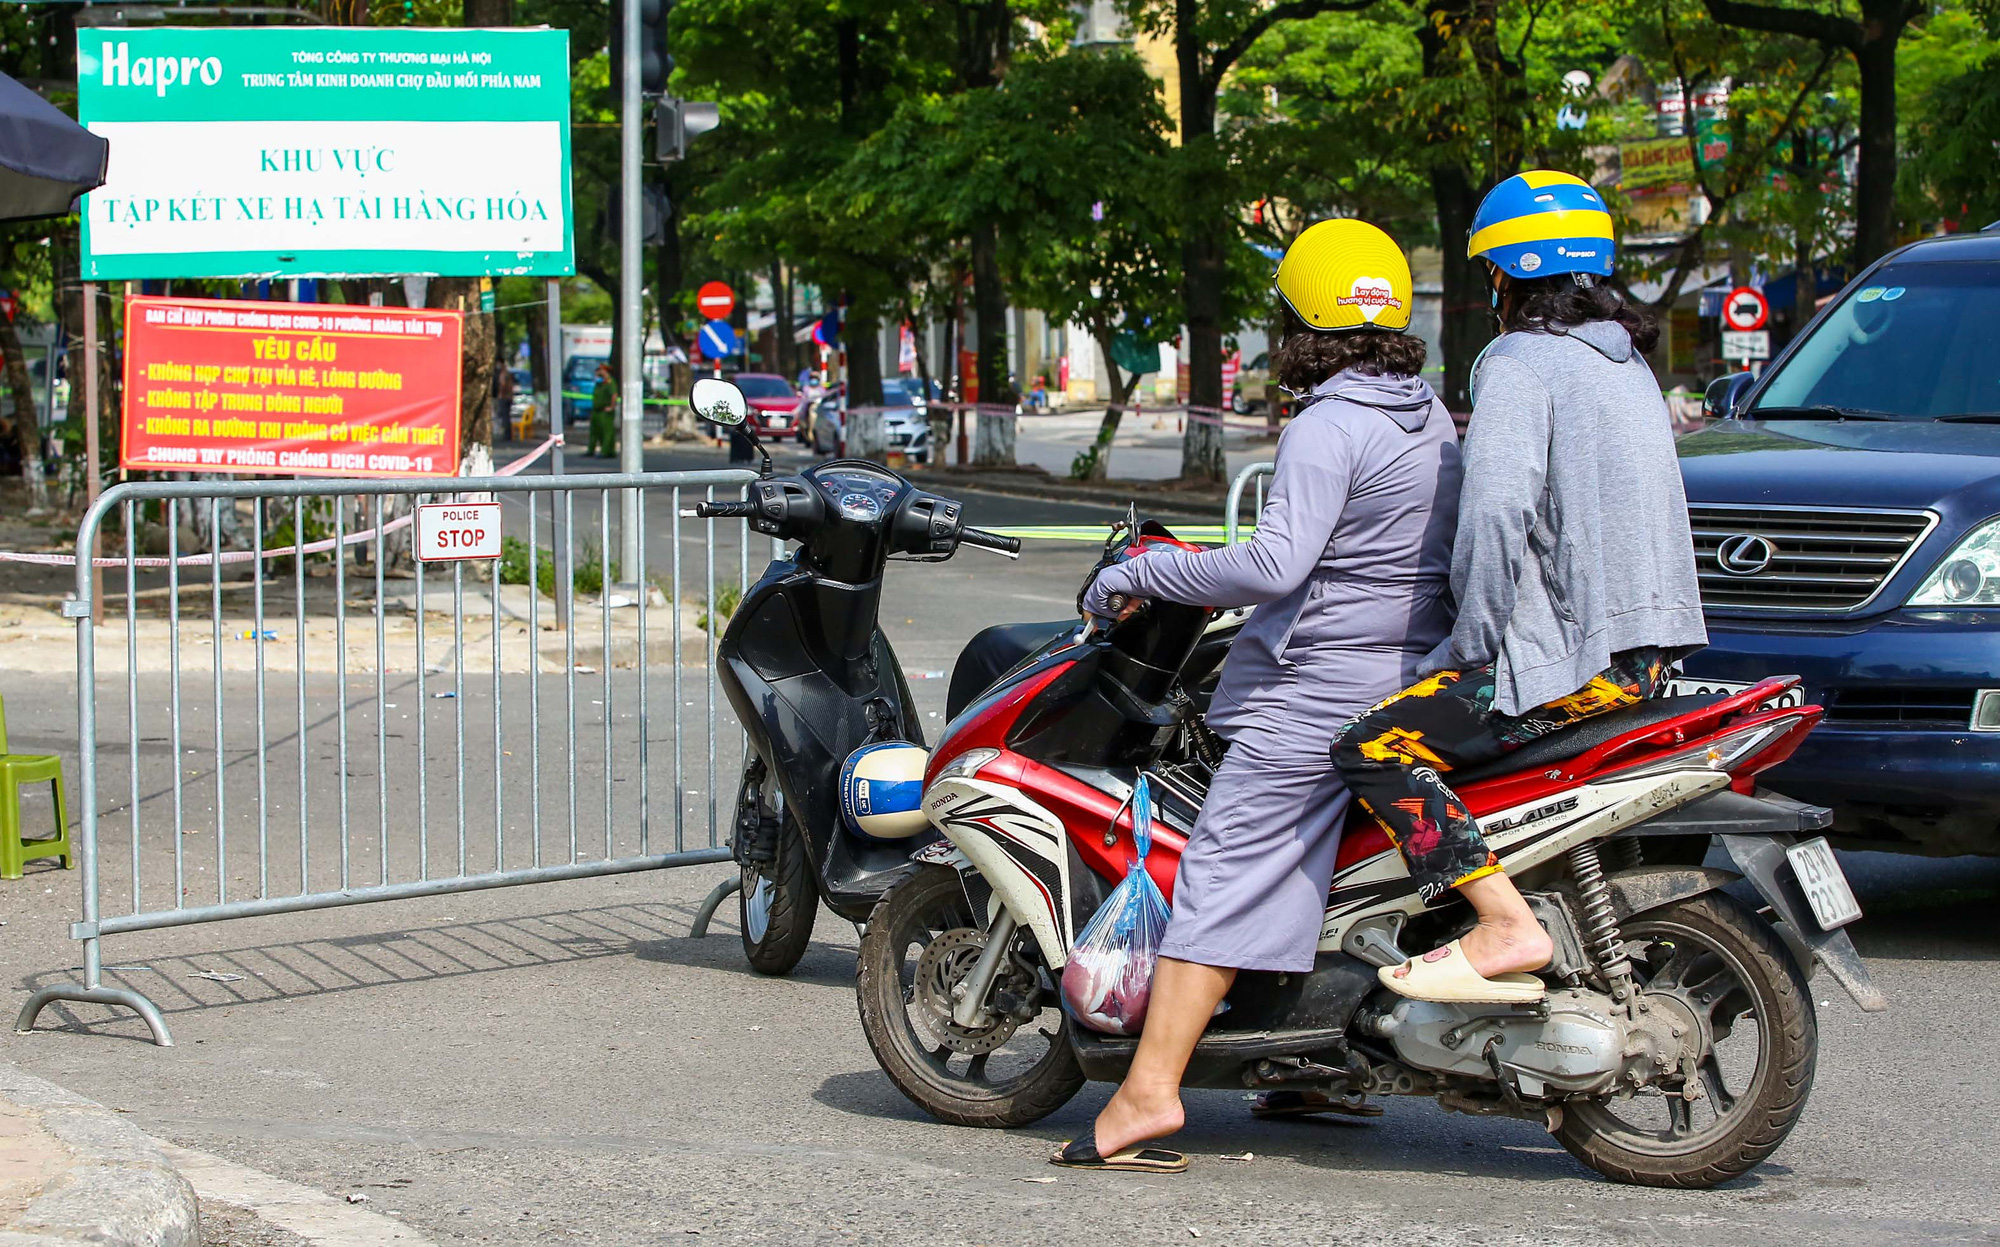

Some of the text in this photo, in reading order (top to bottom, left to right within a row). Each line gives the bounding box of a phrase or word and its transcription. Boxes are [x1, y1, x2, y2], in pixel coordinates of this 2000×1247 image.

[102, 41, 223, 97] Hapro
[326, 49, 360, 64] CÔNG
[362, 52, 376, 64] TY
[430, 53, 451, 66] MẠI
[453, 51, 469, 64] HÀ
[241, 70, 542, 90] TRUNG TÂM KINH DOANH CHỢ ĐẦU MỐI PHÍA NAM
[260, 145, 395, 178] KHU VỰC
[103, 194, 160, 229] TẬP
[168, 190, 227, 222] KẾT
[236, 197, 274, 220] XE
[285, 197, 324, 226] HẠ
[393, 189, 476, 221] HÀNG
[486, 190, 548, 221] HÓA
[292, 315, 333, 331] COVID-19
[253, 335, 291, 361] YÊU
[147, 360, 192, 382] KHÔNG
[194, 364, 221, 386] HỌP
[223, 365, 251, 388] CHỢ
[251, 366, 273, 388] TẠI
[322, 367, 357, 389] LÒNG
[146, 388, 191, 409] KHÔNG
[194, 389, 219, 413] TẬP
[221, 393, 263, 412] TRUNG
[145, 414, 190, 436] KHÔNG
[193, 418, 210, 437] RA
[259, 421, 281, 439] KHI
[283, 420, 328, 442] KHÔNG
[330, 422, 348, 442] CÓ
[350, 422, 379, 446] VIỆC
[411, 423, 447, 446] THIẾT
[147, 446, 433, 472] CHUNG TAY PHÒNG CHỐNG DỊCH COVID-19
[442, 510, 479, 521] POLICE
[437, 528, 485, 548] STOP
[931, 792, 959, 811] HONDA
[1483, 795, 1580, 836] BLADE
[1495, 813, 1568, 839] SPORT EDITION
[1535, 1040, 1593, 1056] HONDA
